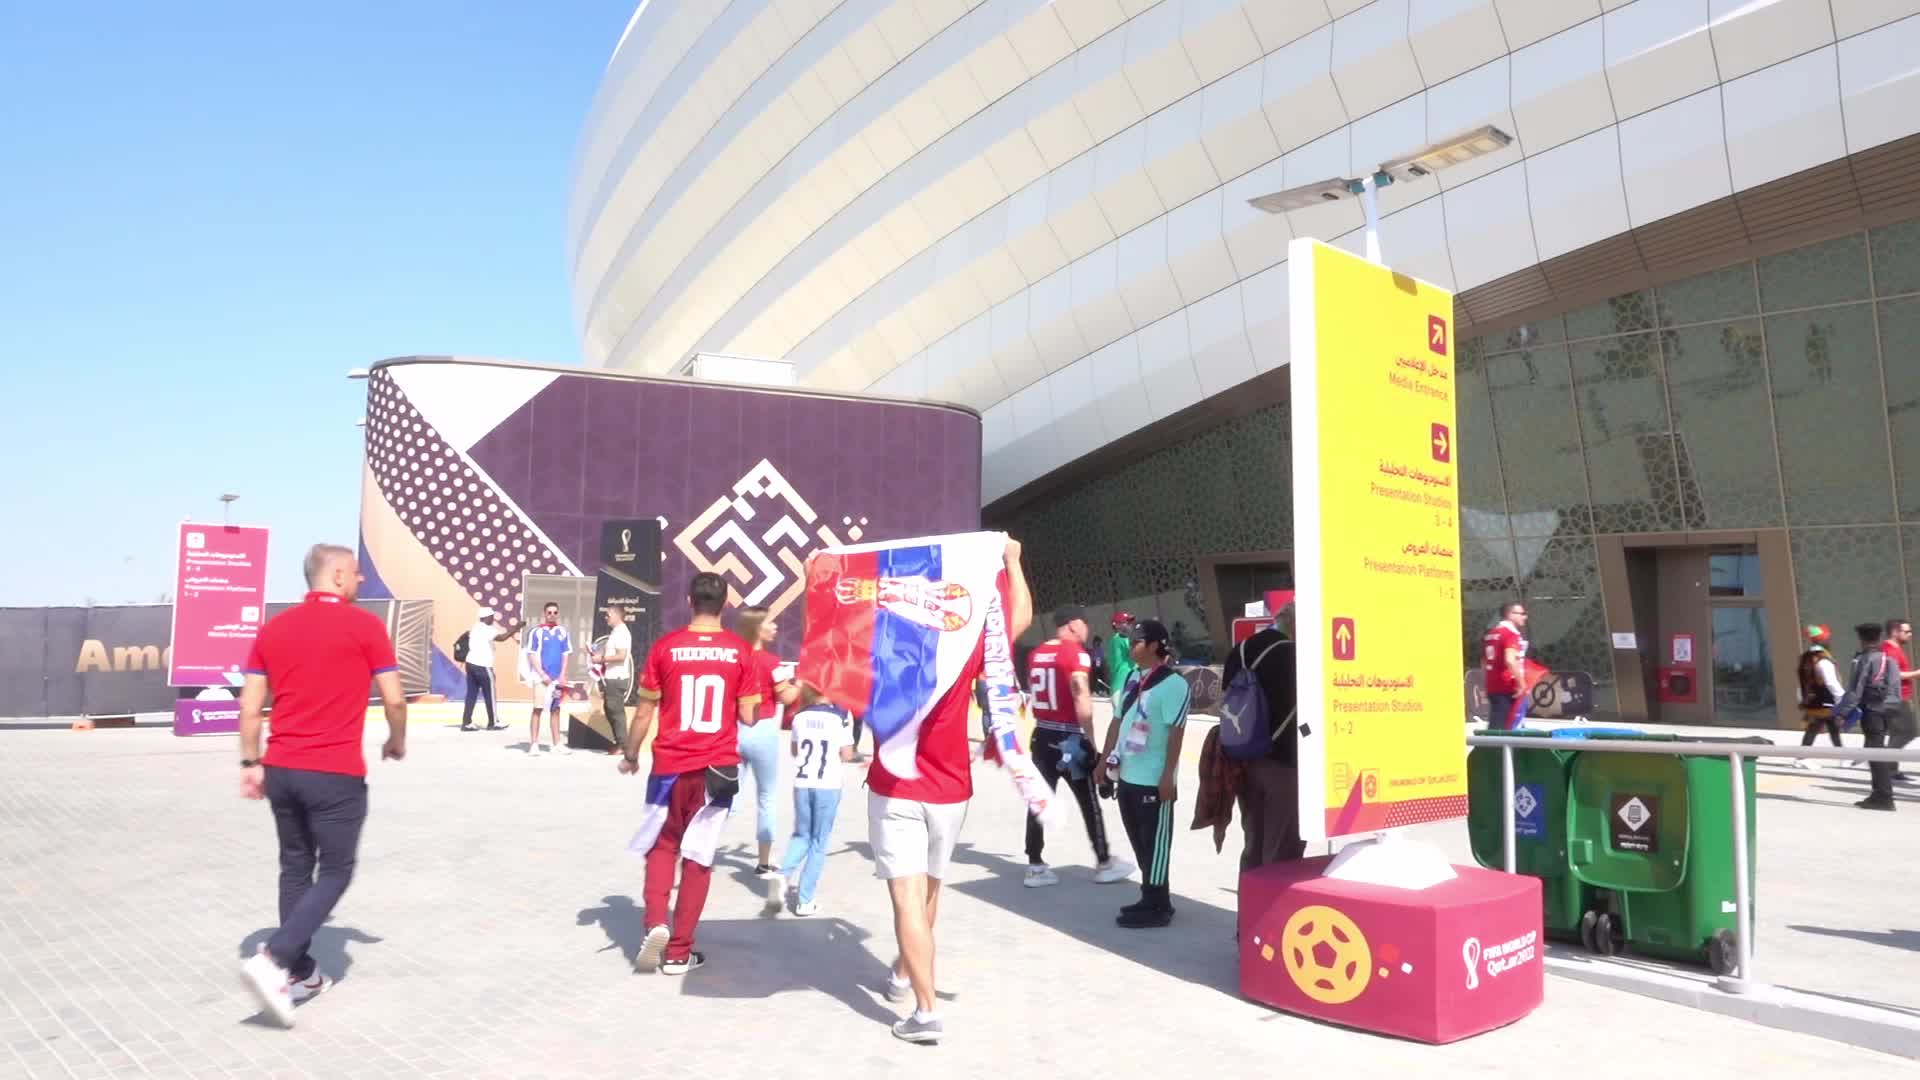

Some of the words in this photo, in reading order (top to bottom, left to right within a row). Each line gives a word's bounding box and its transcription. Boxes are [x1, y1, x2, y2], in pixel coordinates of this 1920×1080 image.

[1388, 370, 1413, 392] Media
[1415, 380, 1449, 402] Entrance
[1370, 480, 1423, 504] Presentation
[1363, 556, 1418, 577] Presentation
[670, 647, 739, 664] TODOROVIC
[1030, 667, 1058, 711] 21
[680, 674, 726, 734] 10
[1333, 699, 1391, 713] Presentation
[1391, 699, 1424, 713] Studios
[1347, 720, 1354, 735] 2
[796, 738, 828, 779] 21
[1482, 944, 1502, 961] FIFA
